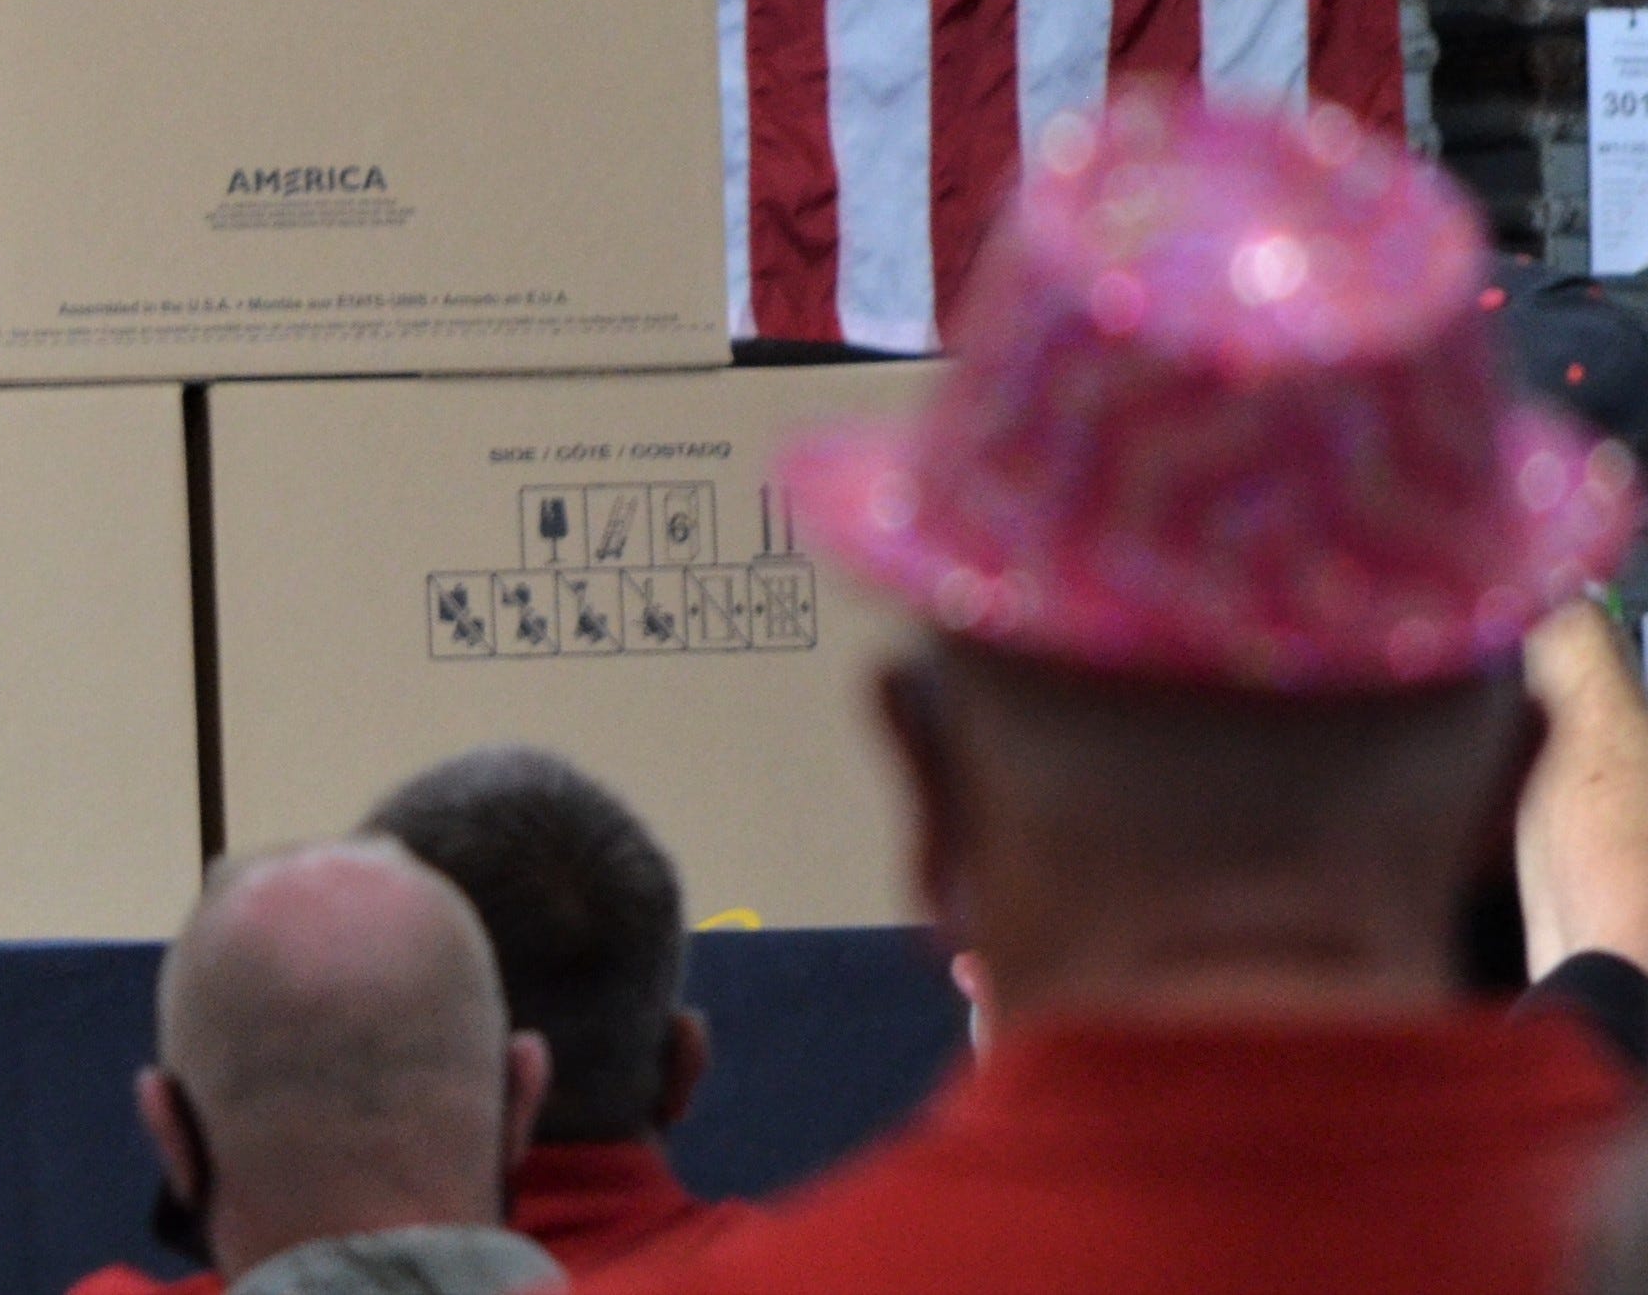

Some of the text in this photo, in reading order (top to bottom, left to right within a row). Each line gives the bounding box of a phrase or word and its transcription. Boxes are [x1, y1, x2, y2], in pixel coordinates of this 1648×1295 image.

[226, 164, 389, 196] AMERICA
[489, 446, 536, 463] SIDE
[630, 440, 733, 460] COSTADO
